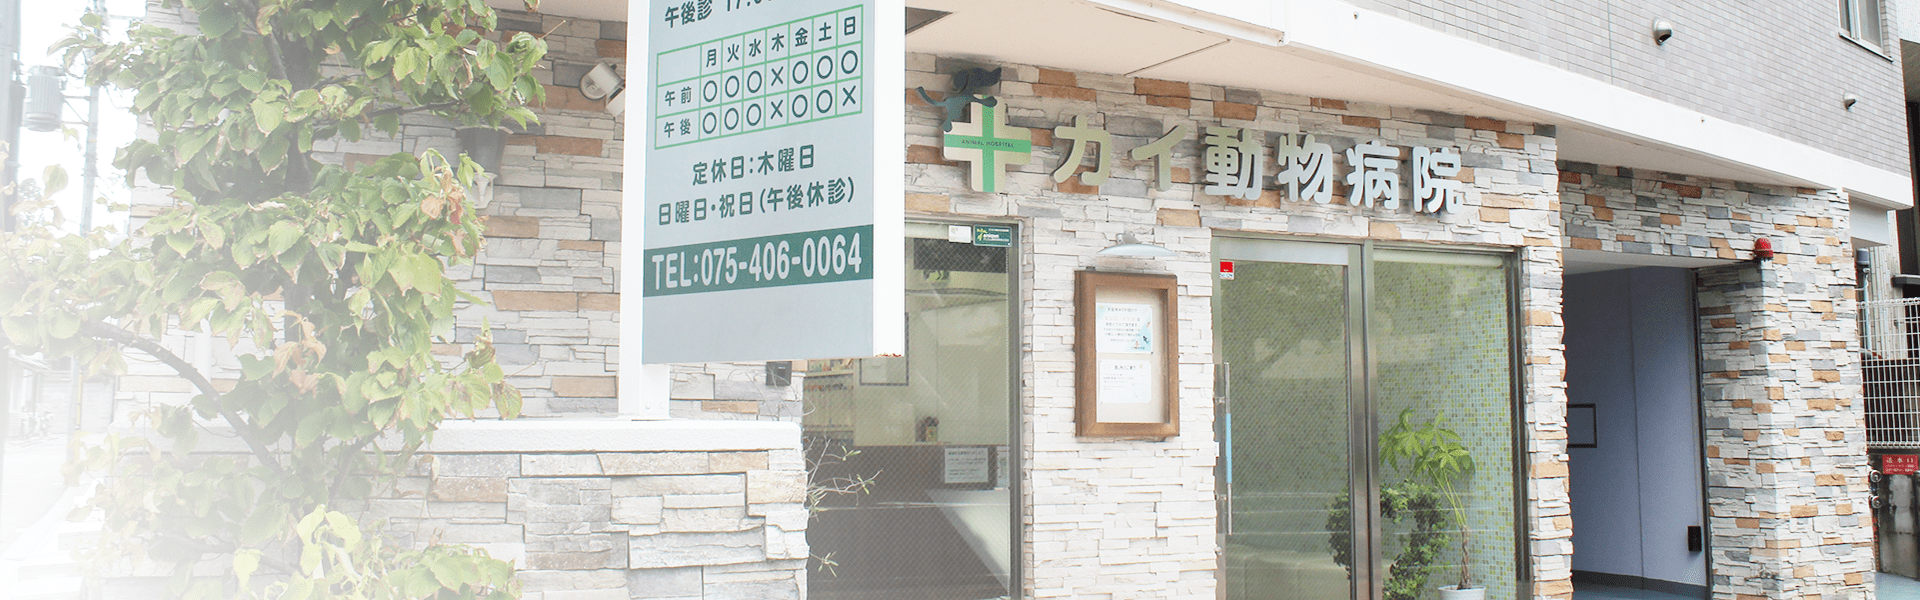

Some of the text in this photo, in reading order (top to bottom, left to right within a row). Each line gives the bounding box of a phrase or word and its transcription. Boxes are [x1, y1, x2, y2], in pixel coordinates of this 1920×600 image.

[664, 0, 713, 28] 午後診
[705, 16, 856, 68] 月 火 水 木 金 土 日
[664, 86, 692, 107] 午前
[663, 118, 691, 139] 午後
[692, 144, 815, 186] 定休日:木曜日
[1053, 114, 1463, 214] カイ動物病院
[651, 232, 862, 290] TEL:075-406-0064
